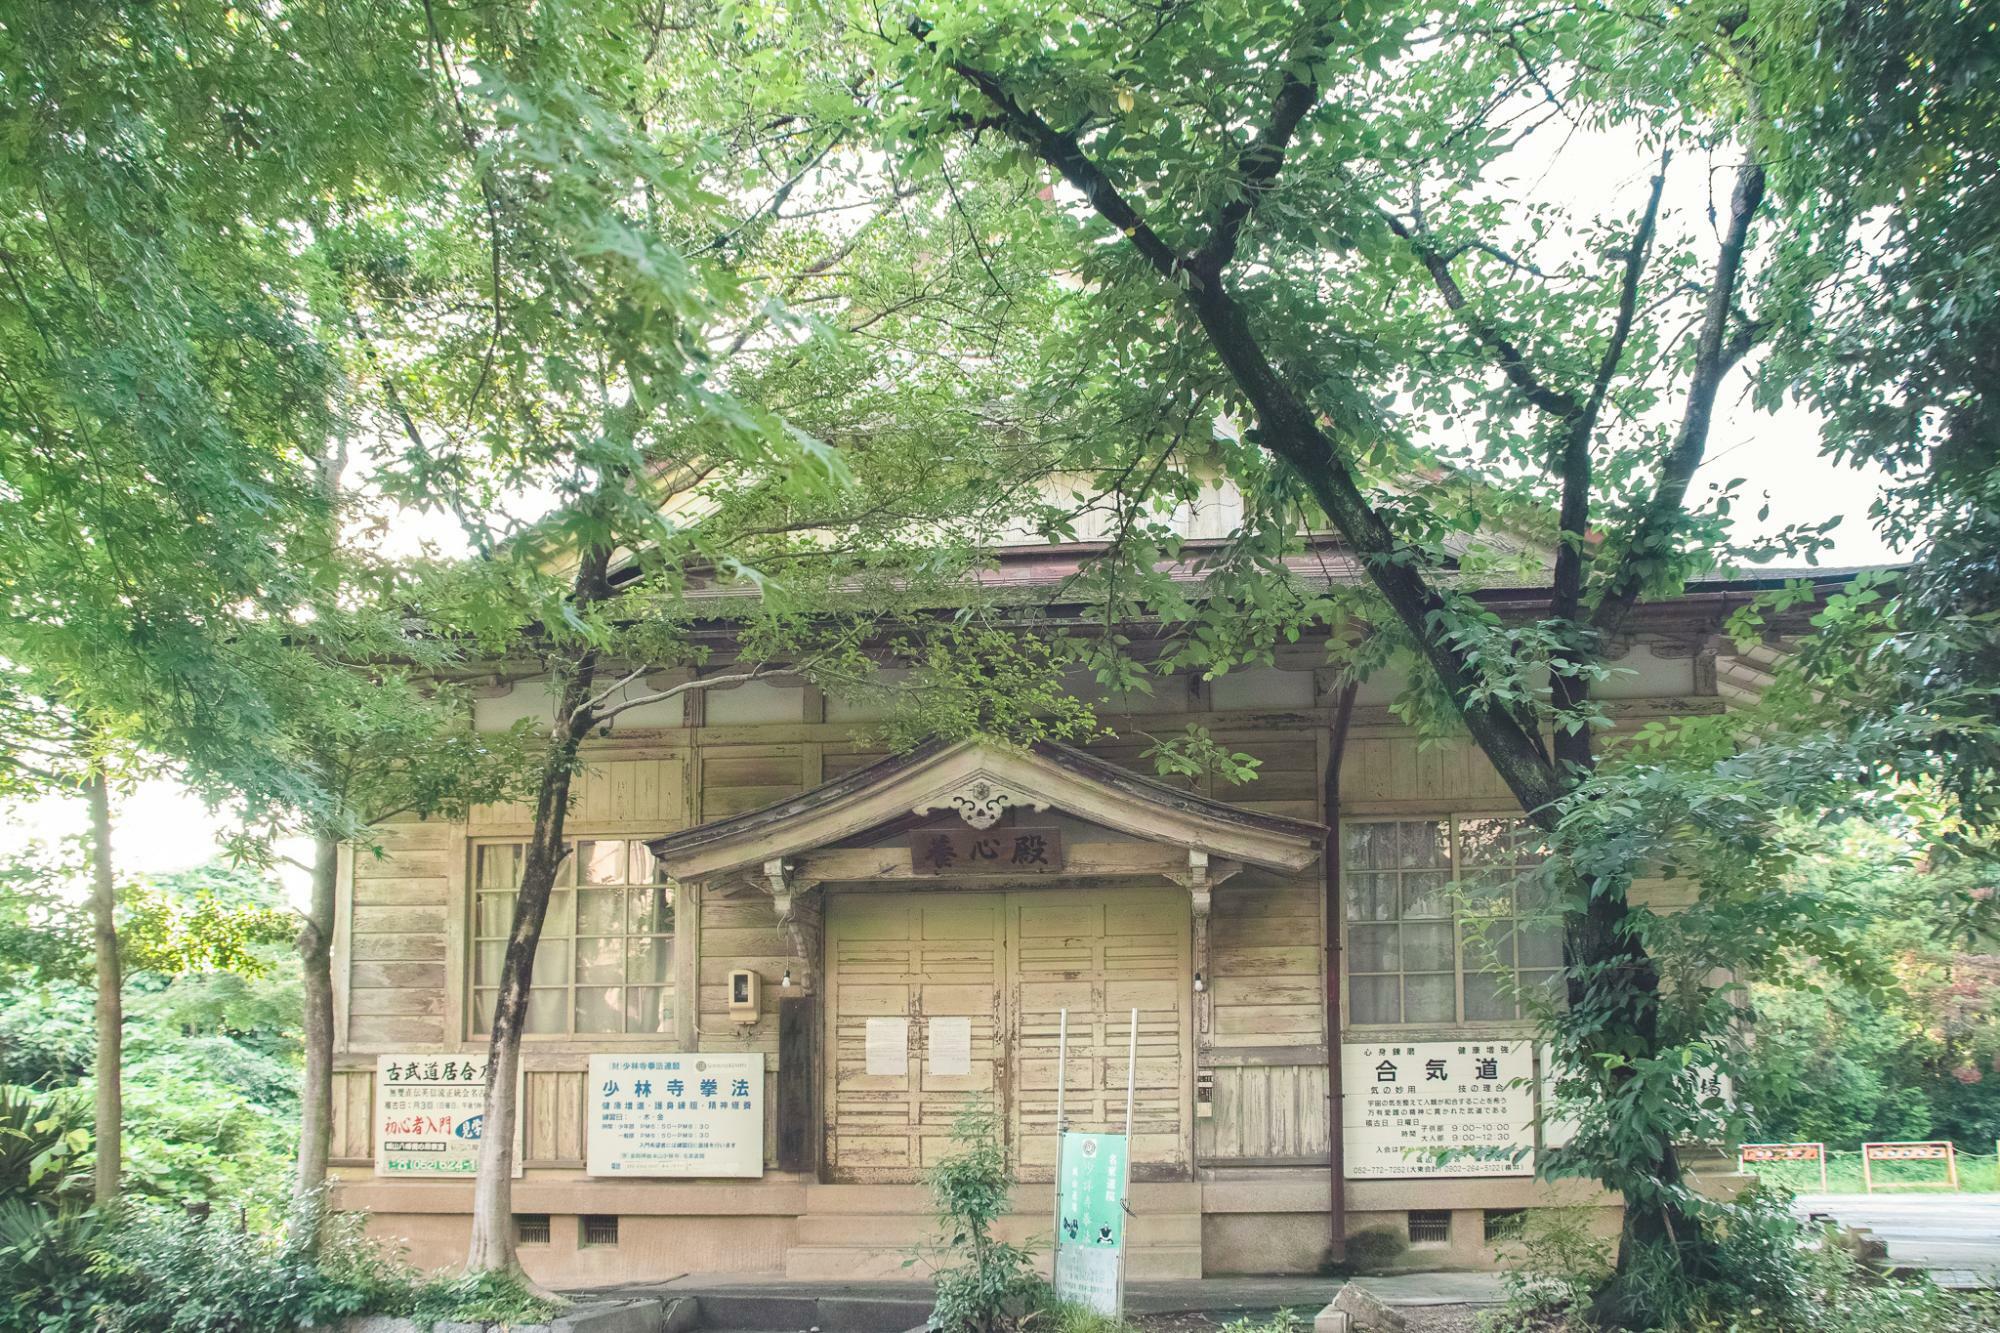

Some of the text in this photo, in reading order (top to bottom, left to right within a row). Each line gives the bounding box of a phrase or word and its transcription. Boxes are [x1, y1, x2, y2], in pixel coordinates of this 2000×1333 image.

[925, 834, 1049, 869] 養心殿
[1458, 1045, 1510, 1055] 健康増強
[1375, 1058, 1498, 1082] 合気道
[602, 1078, 750, 1098] 少林寺拳法
[1370, 1084, 1505, 1095] 気の妙用 技の理合
[385, 1116, 451, 1135] 初心者入門
[1365, 1118, 1421, 1127] 稽古日 日曜日
[1420, 1134, 1445, 1142] 大人部
